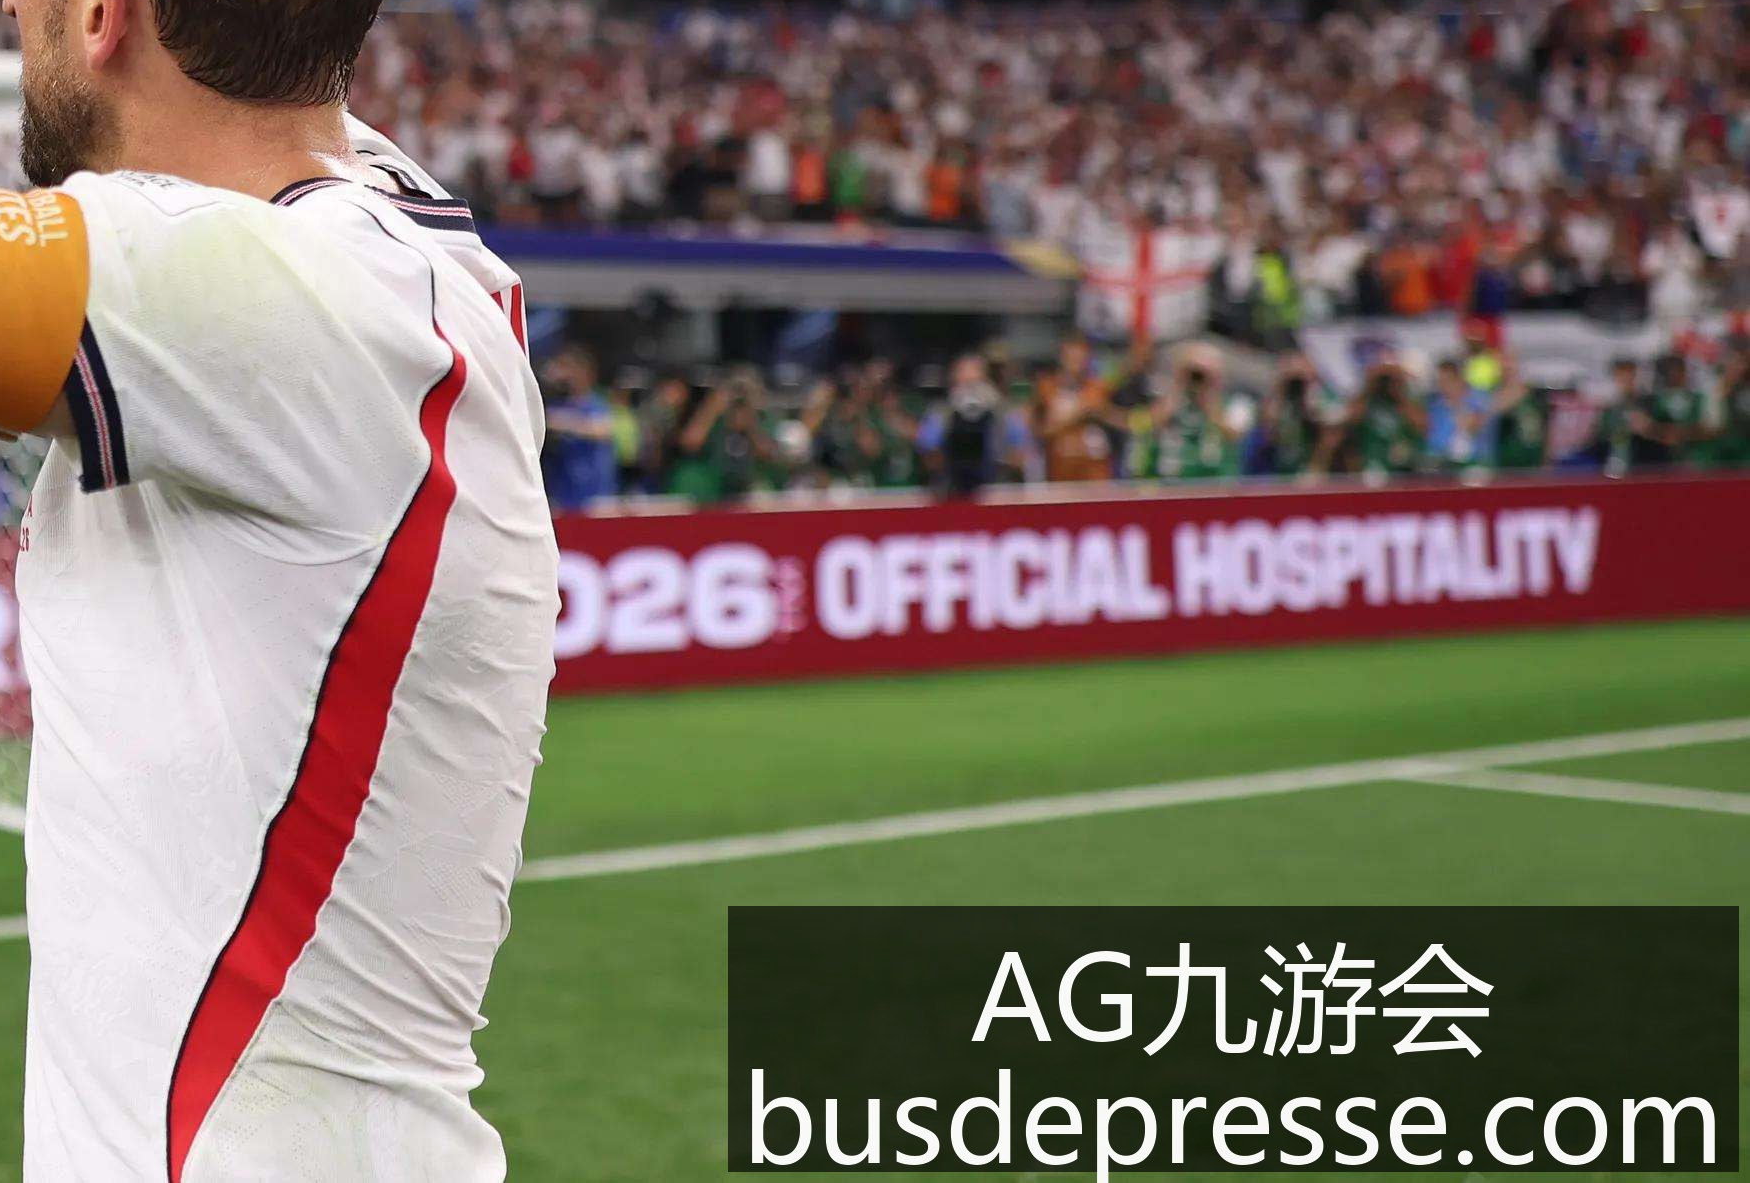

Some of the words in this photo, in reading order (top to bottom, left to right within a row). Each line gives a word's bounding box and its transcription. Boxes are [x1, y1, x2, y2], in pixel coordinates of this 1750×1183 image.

[26, 188, 69, 248] BALL
[556, 543, 776, 659] 026
[816, 527, 1170, 638] OFFICIAL
[1173, 507, 1600, 617] HOSPITALITY
